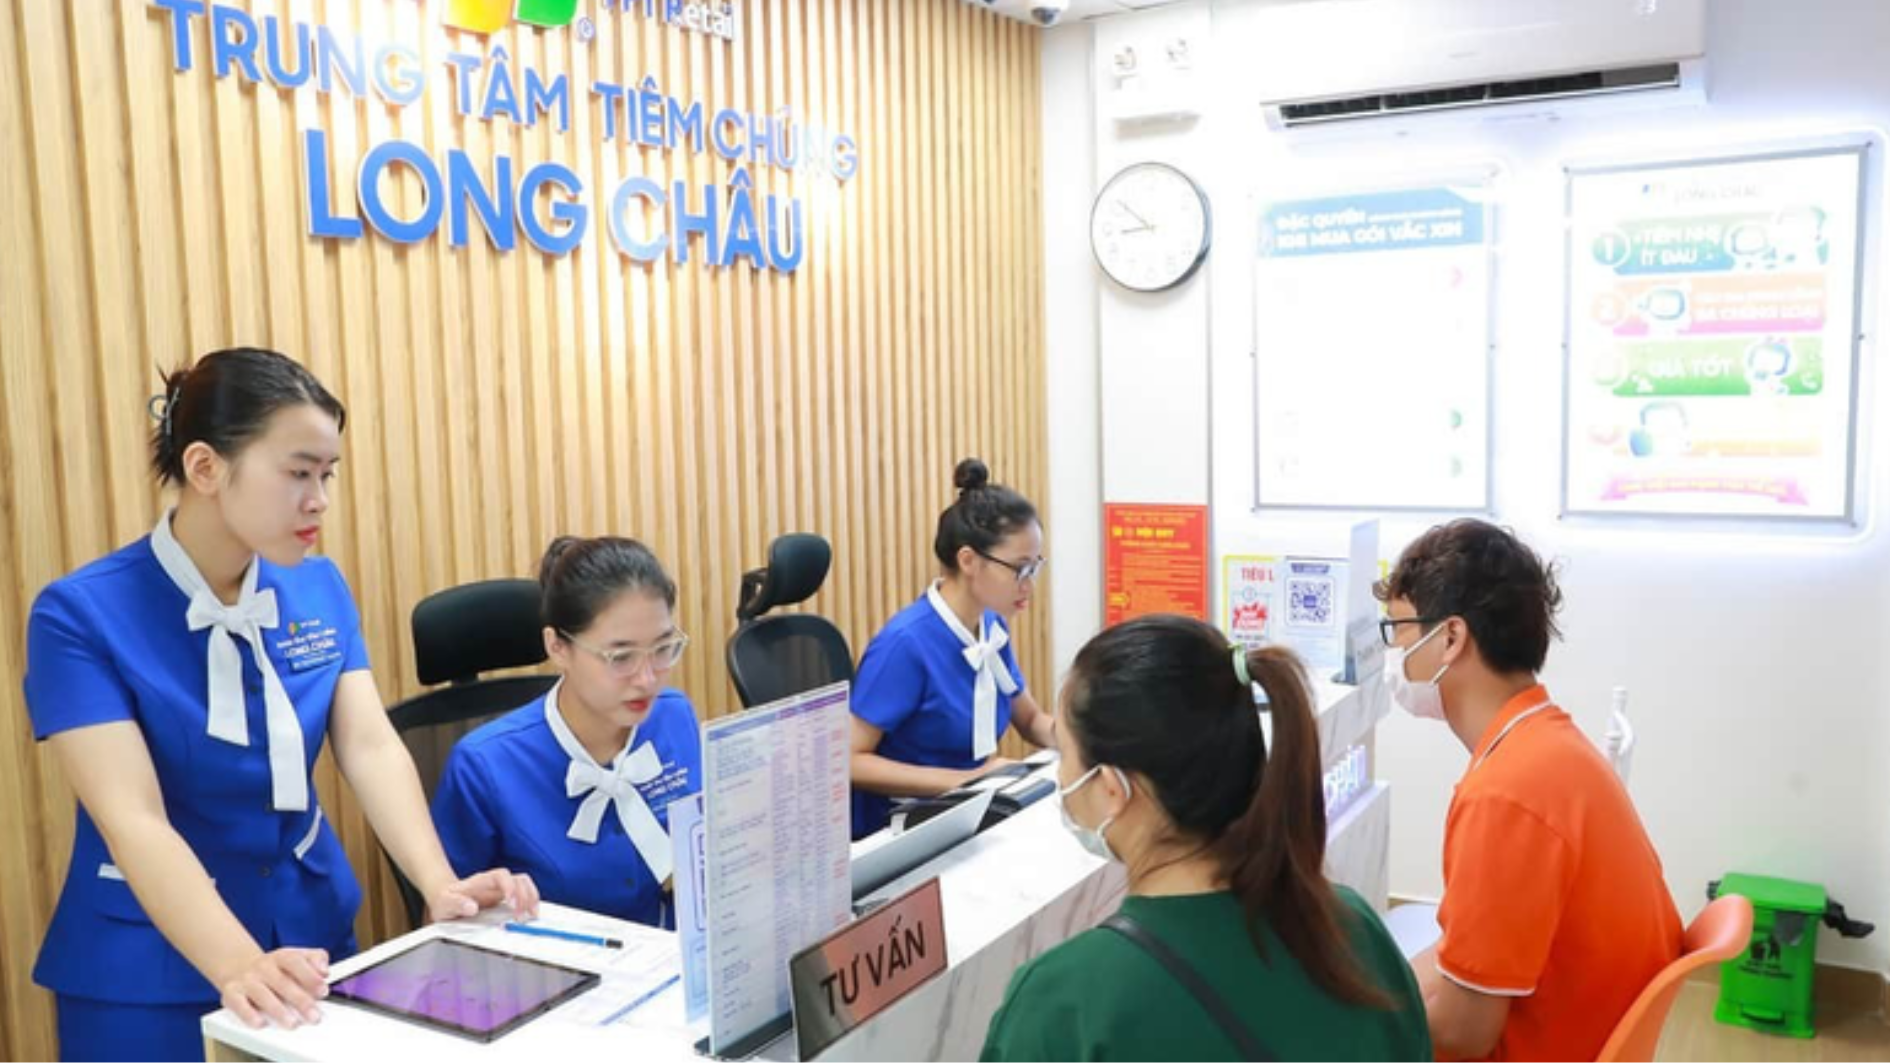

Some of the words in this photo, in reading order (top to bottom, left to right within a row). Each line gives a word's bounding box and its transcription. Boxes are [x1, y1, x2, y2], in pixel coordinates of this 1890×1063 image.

[155, 0, 425, 105] TRUNG
[447, 45, 569, 132] TÂM
[593, 76, 703, 153] TIÊM
[306, 128, 588, 255] LONG
[609, 167, 802, 272] CHÂU
[819, 955, 860, 1015] TƯ
[865, 915, 925, 987] VẤN
